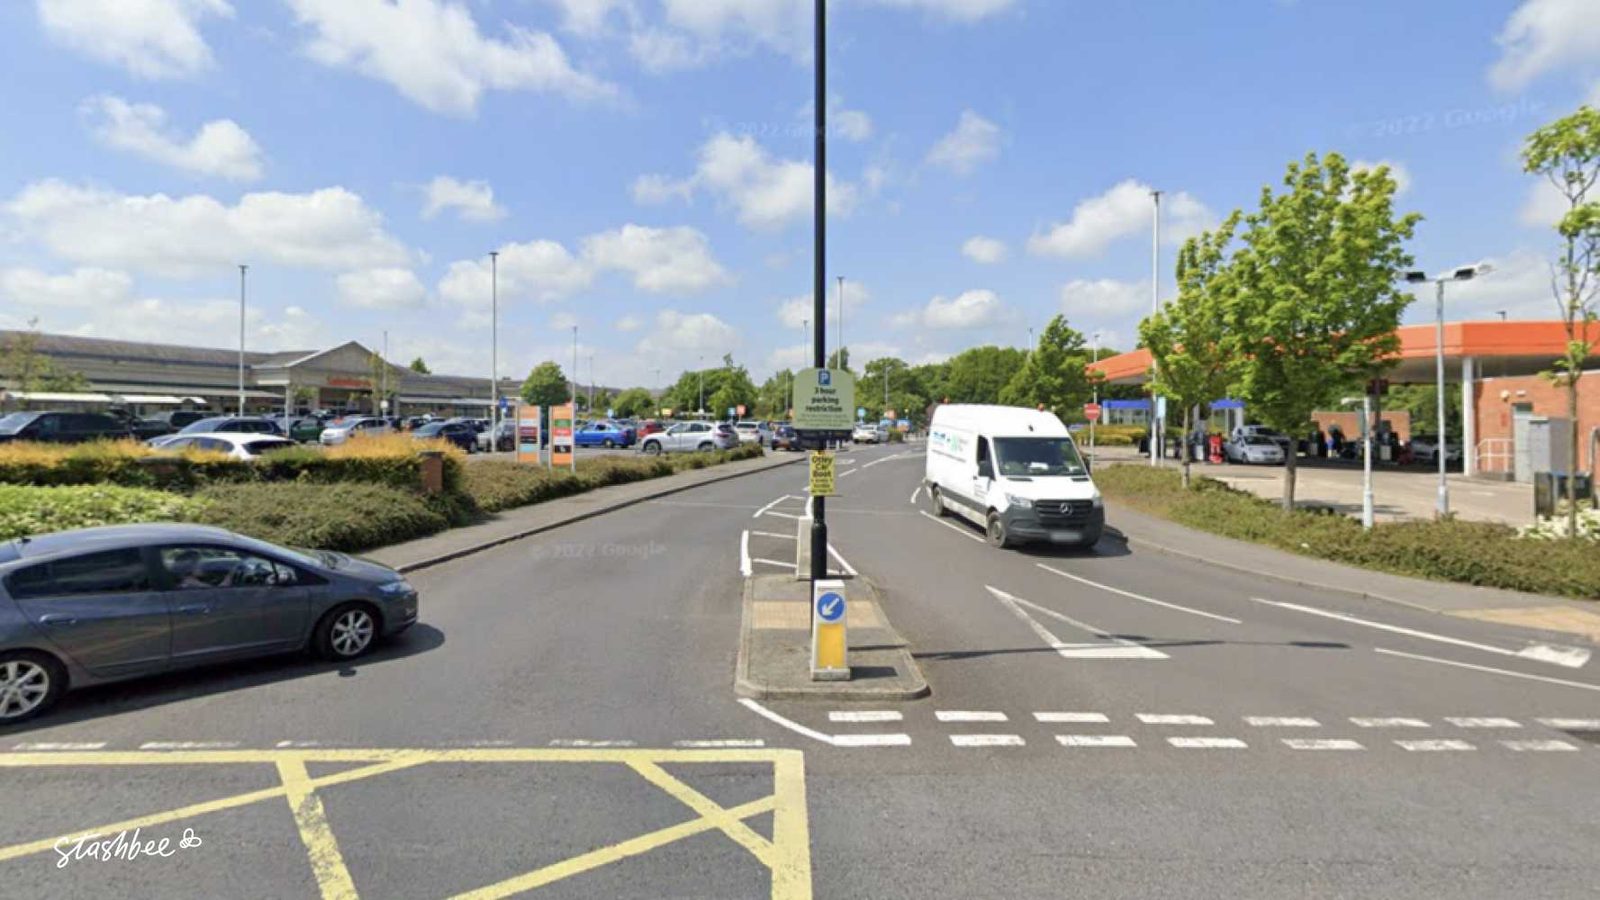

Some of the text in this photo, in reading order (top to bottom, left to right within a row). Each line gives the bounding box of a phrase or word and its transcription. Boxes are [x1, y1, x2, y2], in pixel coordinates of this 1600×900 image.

[820, 387, 837, 395] hour
[811, 396, 839, 405] parking
[805, 405, 843, 413] restriction
[812, 470, 831, 478] Boot
